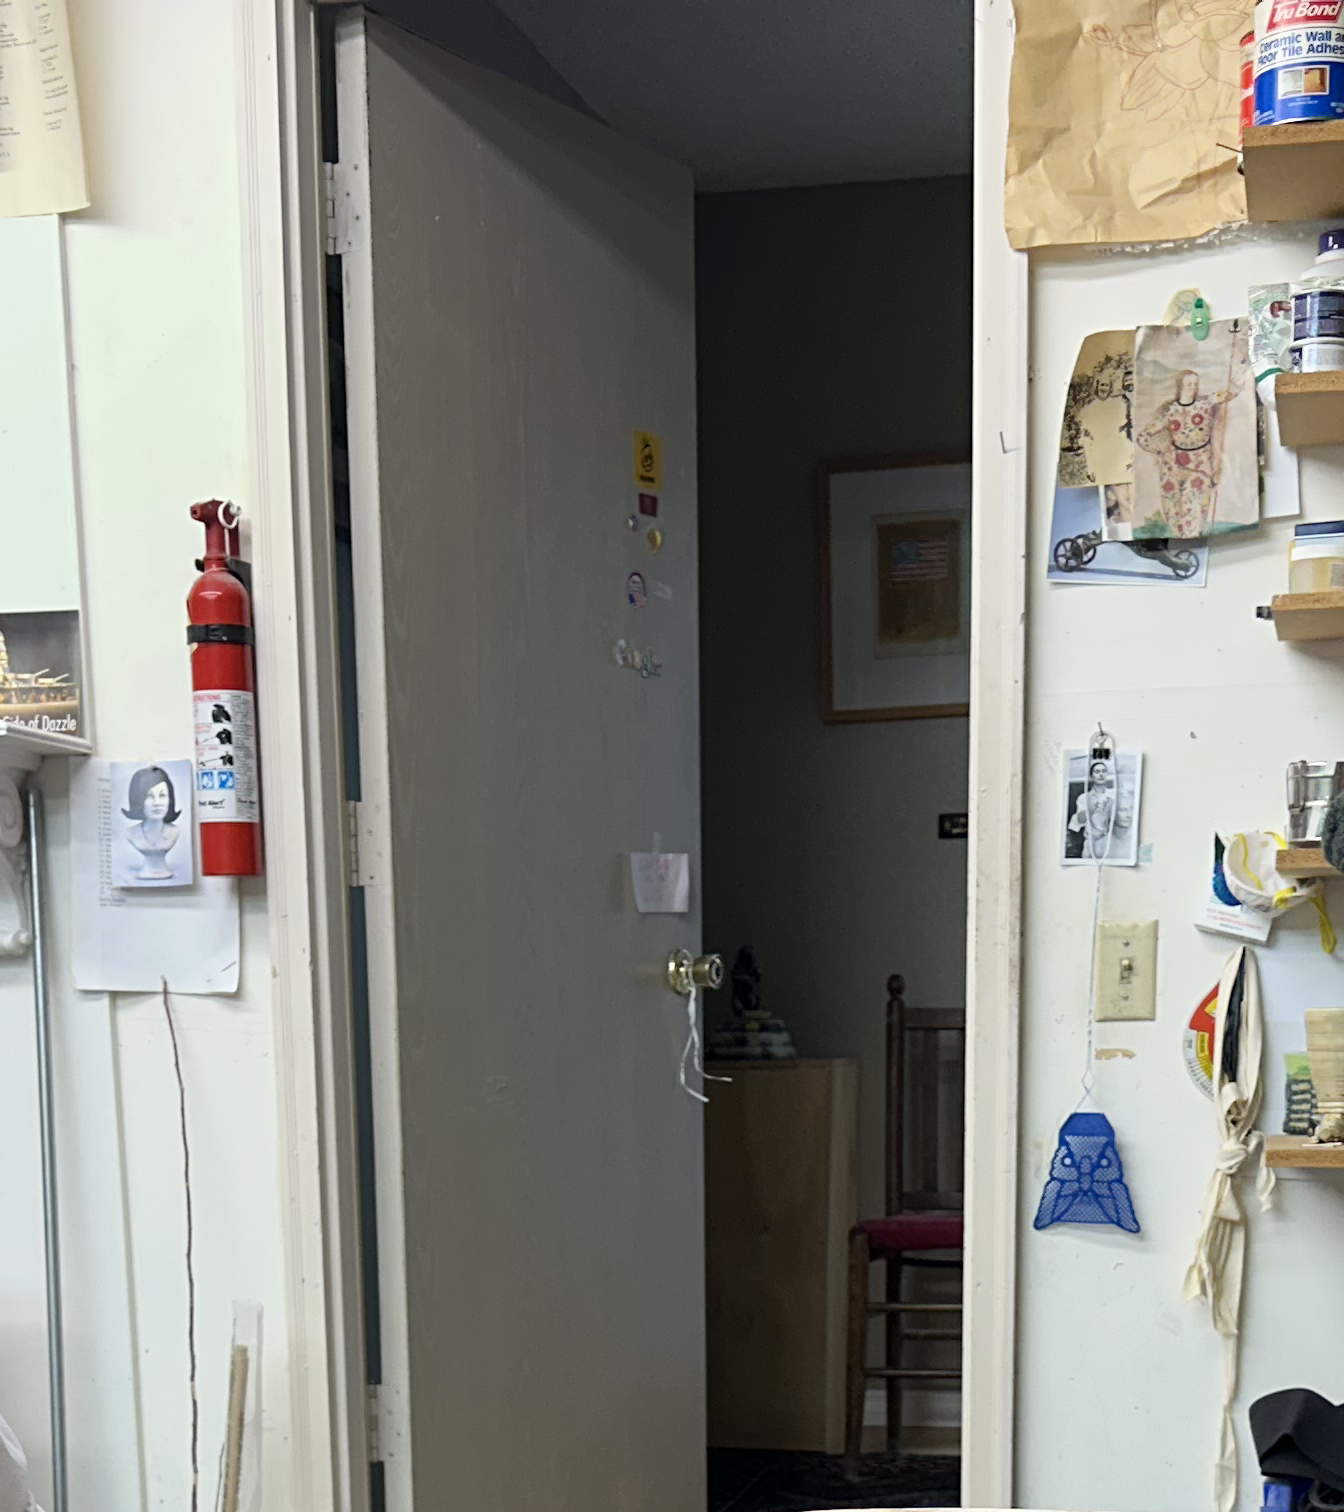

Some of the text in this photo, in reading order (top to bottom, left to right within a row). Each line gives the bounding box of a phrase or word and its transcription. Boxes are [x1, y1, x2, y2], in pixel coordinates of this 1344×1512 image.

[1306, 31, 1331, 42] Wall
[1282, 45, 1303, 57] Tile
[42, 714, 77, 732] Dazzle
